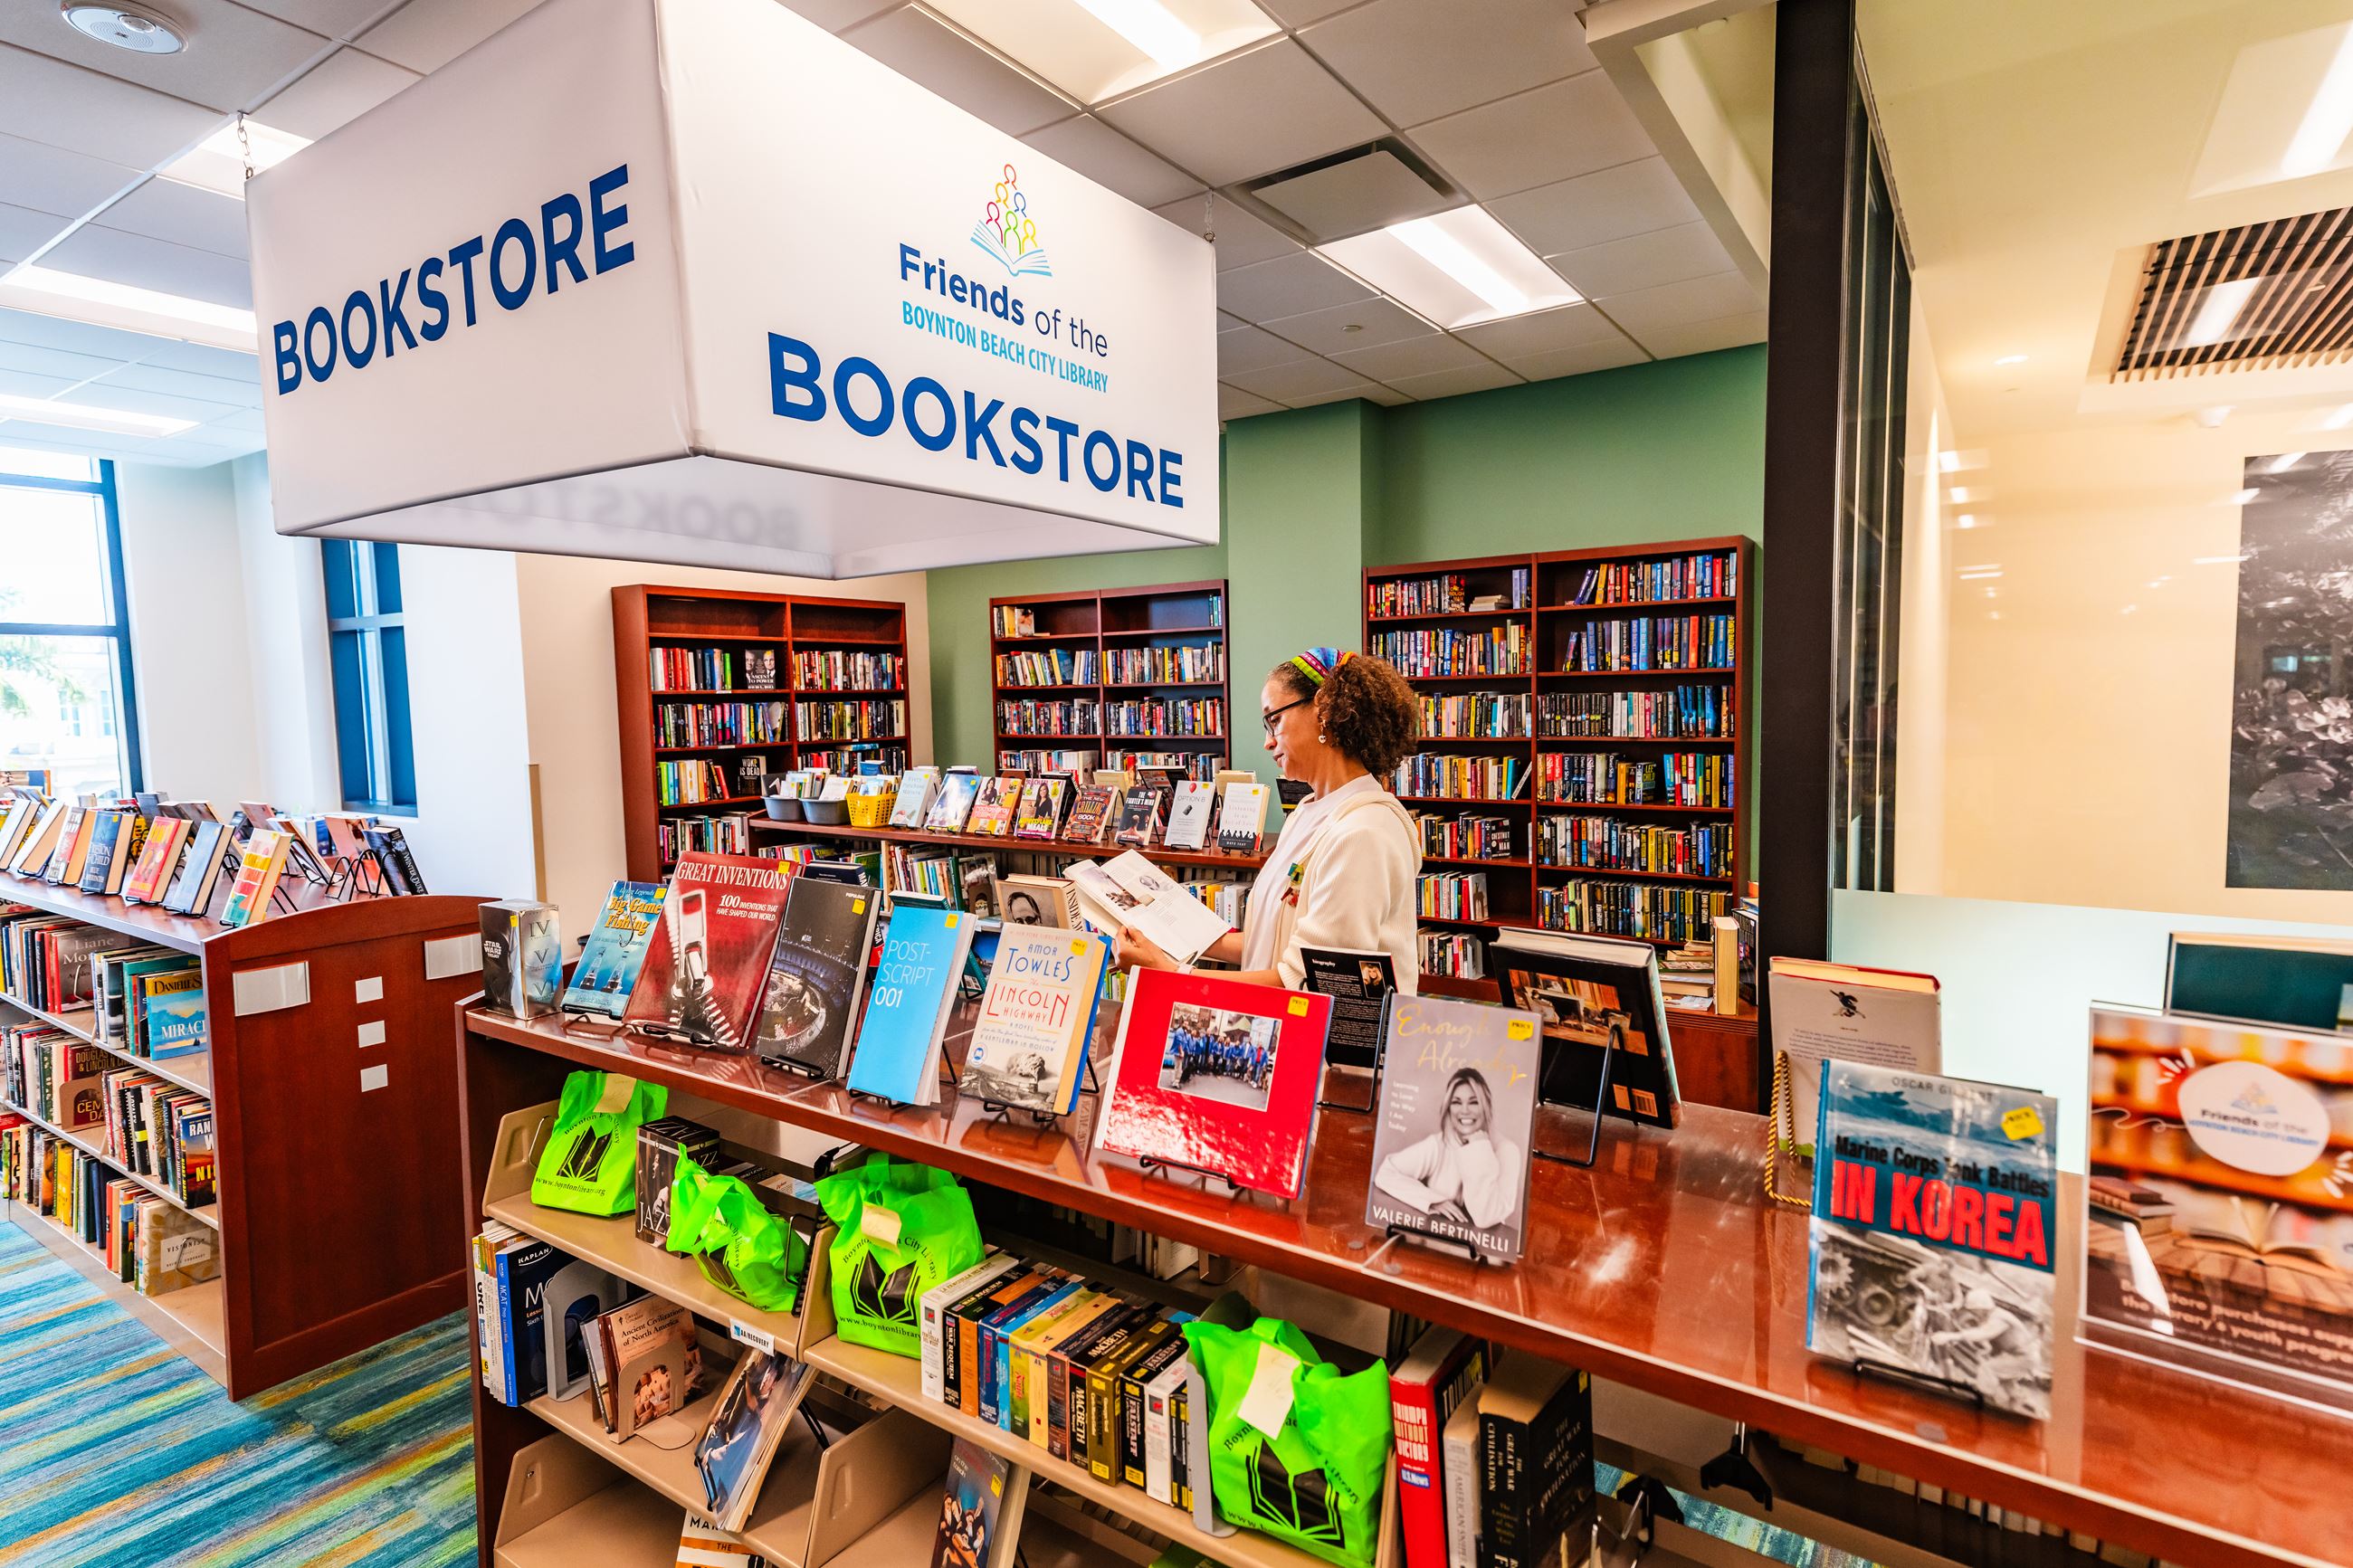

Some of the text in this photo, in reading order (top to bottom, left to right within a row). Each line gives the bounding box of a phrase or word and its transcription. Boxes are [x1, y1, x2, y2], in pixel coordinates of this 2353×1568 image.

[273, 164, 634, 395] BOOKSTORE
[900, 242, 1107, 356] Friends of the
[902, 300, 1108, 393] BOYNTON BEACH CITY LIBRARY
[768, 332, 1183, 508] BOOKSTORE
[677, 861, 790, 890] GREAT INVENTIONS
[607, 896, 662, 916] Big Game
[716, 907, 776, 921] HAVE SHAPED OUR WORLD
[719, 894, 779, 913] 100 INVENTIONS THAT
[529, 919, 550, 937] IV
[605, 914, 650, 936] Fishing
[73, 936, 114, 950] Liane
[484, 940, 501, 948] STAR
[484, 946, 502, 955] WARS
[887, 939, 932, 963] POST-
[1028, 944, 1057, 955] AMOR
[881, 963, 936, 986] SCRIPT
[1006, 948, 1073, 982] TOWLES
[154, 979, 192, 994] DANIELLE
[874, 986, 903, 1008] 001
[987, 984, 1070, 1028] LINCOLN
[1004, 1007, 1047, 1022] HIGHWAY
[76, 1050, 107, 1064] DOUGLAS
[79, 1058, 116, 1073] & LINCOLN
[1891, 1077, 1933, 1093] OSCAR
[2201, 1108, 2260, 1127] Friends
[1835, 1135, 1888, 1165] Marine
[1893, 1146, 1939, 1176] Corps
[1987, 1165, 2049, 1198] Battles
[1831, 1160, 2048, 1267] IN KOREA
[1372, 1205, 1510, 1253] VALERIE BERTINELLI
[518, 1247, 549, 1265] KAPLAN
[843, 1236, 921, 1265] Boynto City
[500, 1285, 508, 1305] MCAT
[527, 1316, 539, 1326] Sixth
[621, 1325, 645, 1337] Ancient
[632, 1330, 653, 1343] North
[653, 1319, 679, 1334] America
[740, 1330, 769, 1348] AA/RECOVERY
[1088, 1328, 1129, 1359] MACBETH
[1075, 1386, 1086, 1444] MACBETH
[1393, 1401, 1428, 1424] TRIUMPH
[1129, 1400, 1138, 1457] FALSTAFF
[1394, 1423, 1428, 1443] WITHOUT
[1396, 1439, 1429, 1462] VICTORY
[1506, 1433, 1515, 1491] GREAT WAR
[1454, 1475, 1464, 1524] AMERICAN
[717, 1542, 732, 1551] THE
